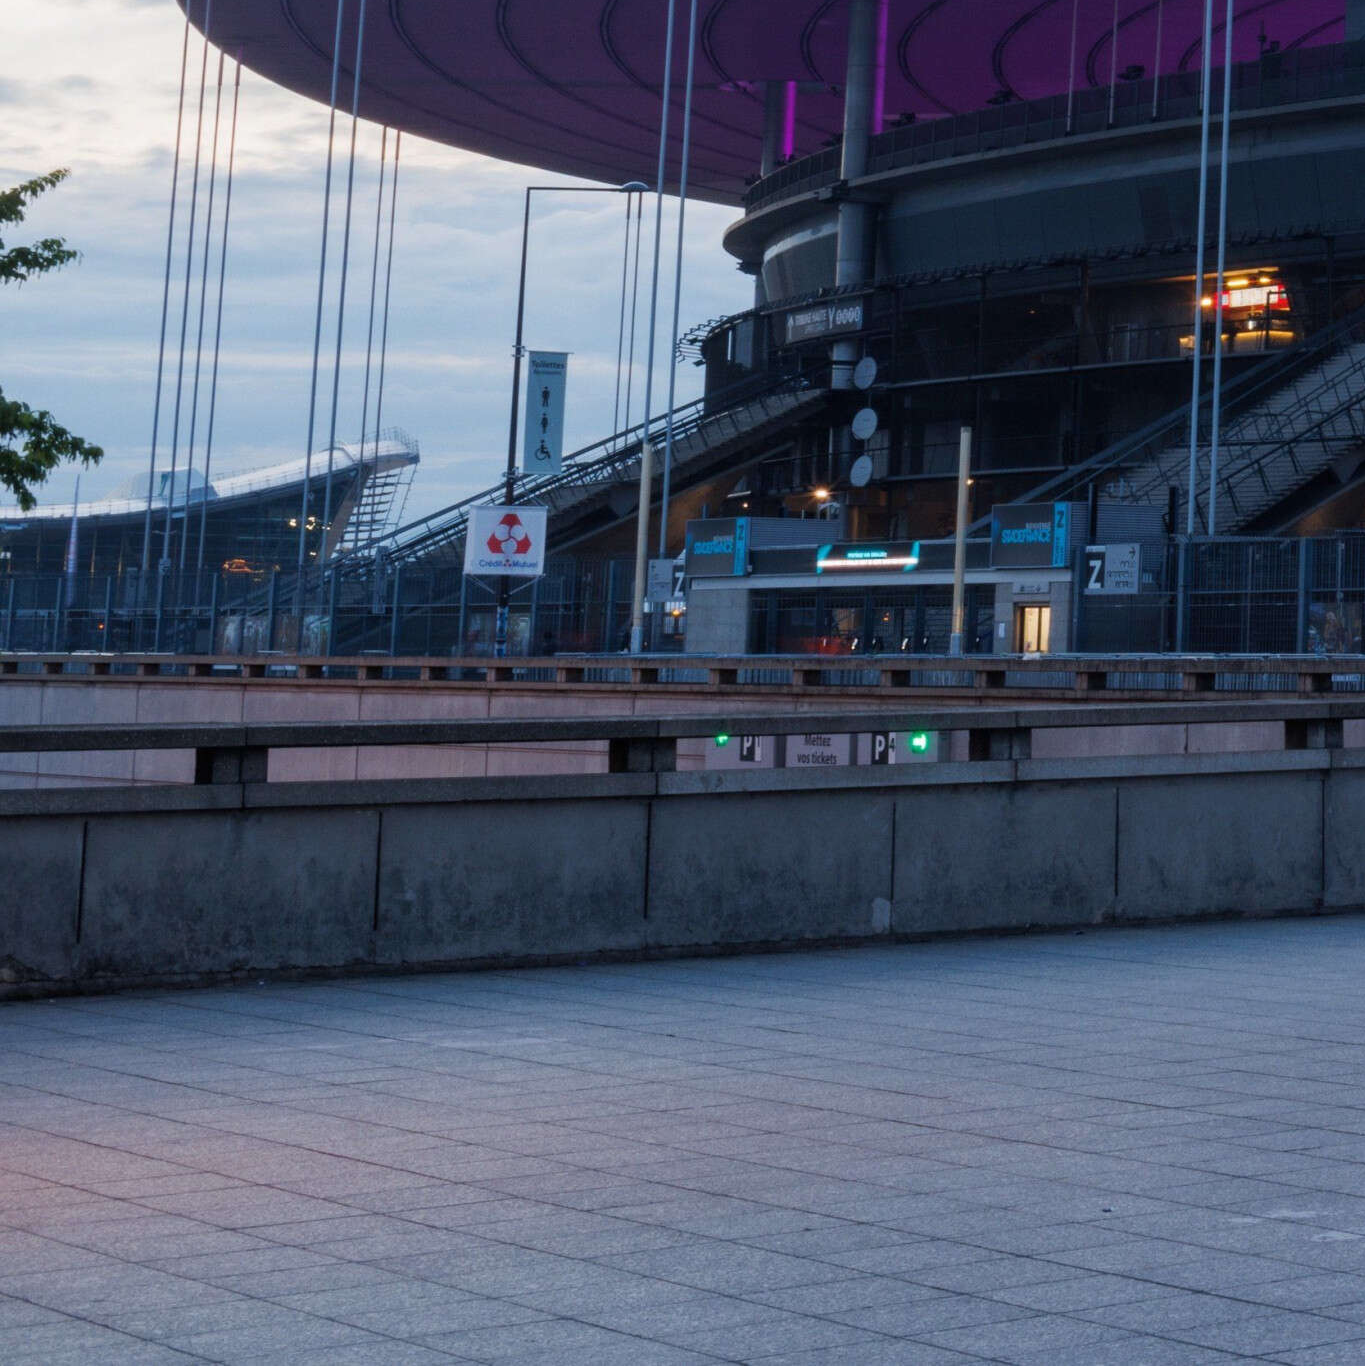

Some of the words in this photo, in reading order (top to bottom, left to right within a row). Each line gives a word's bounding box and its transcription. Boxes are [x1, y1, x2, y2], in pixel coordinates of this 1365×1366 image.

[1088, 559, 1102, 589] Z
[803, 733, 831, 747] Mettez
[797, 754, 810, 764] vos
[811, 752, 837, 765] tickets
